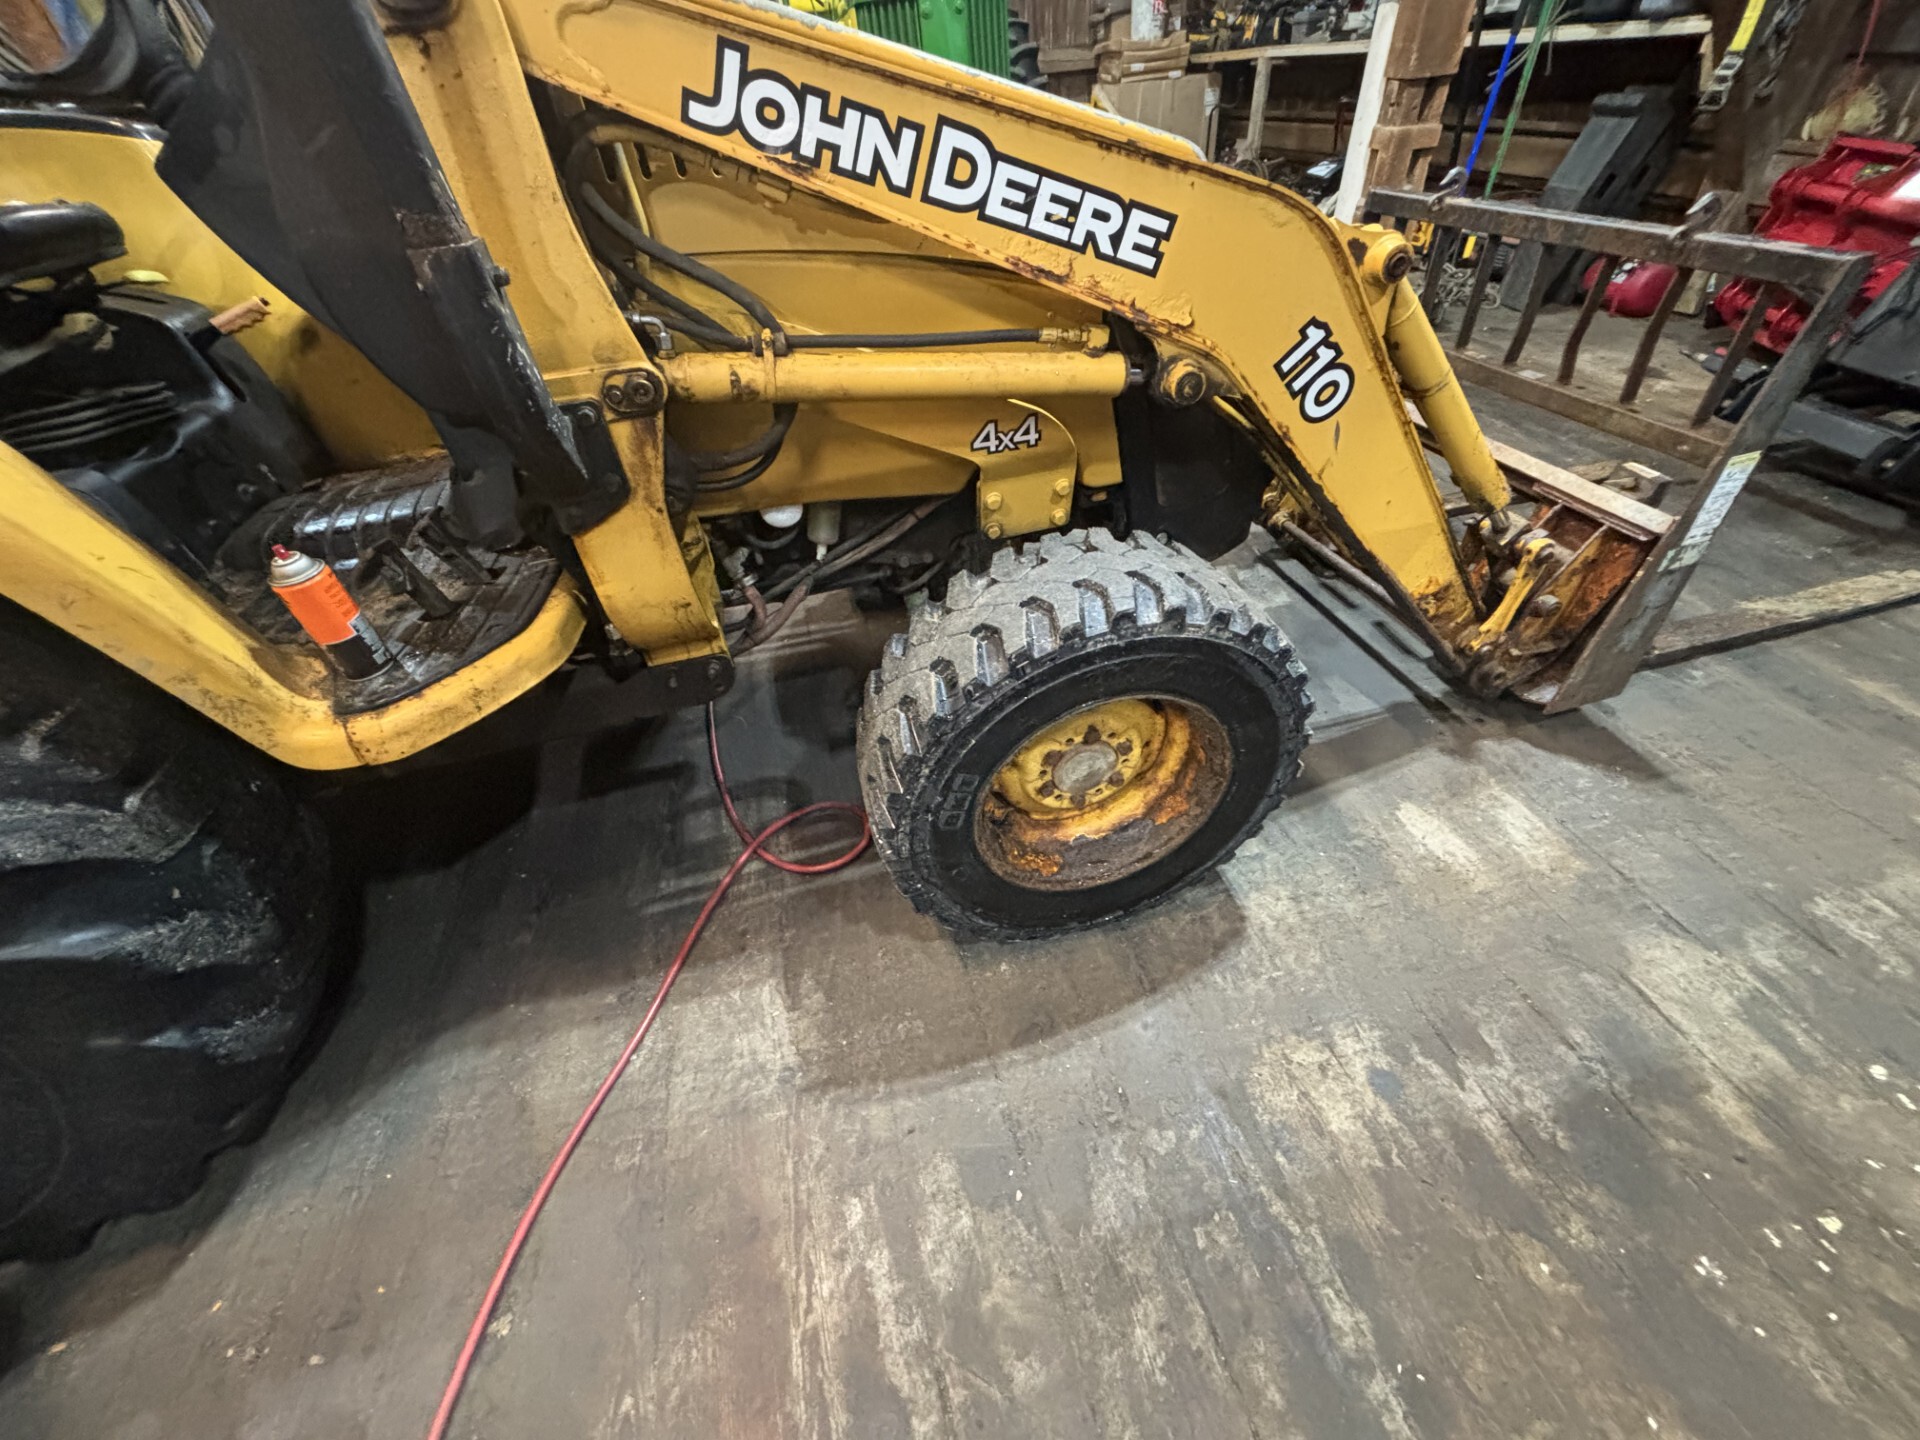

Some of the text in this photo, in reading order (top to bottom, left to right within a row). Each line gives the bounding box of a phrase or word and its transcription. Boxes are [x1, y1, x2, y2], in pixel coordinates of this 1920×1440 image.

[687, 47, 1171, 271] JOHN DEERE
[1279, 323, 1352, 419] 110
[972, 414, 1040, 453] 4x4
